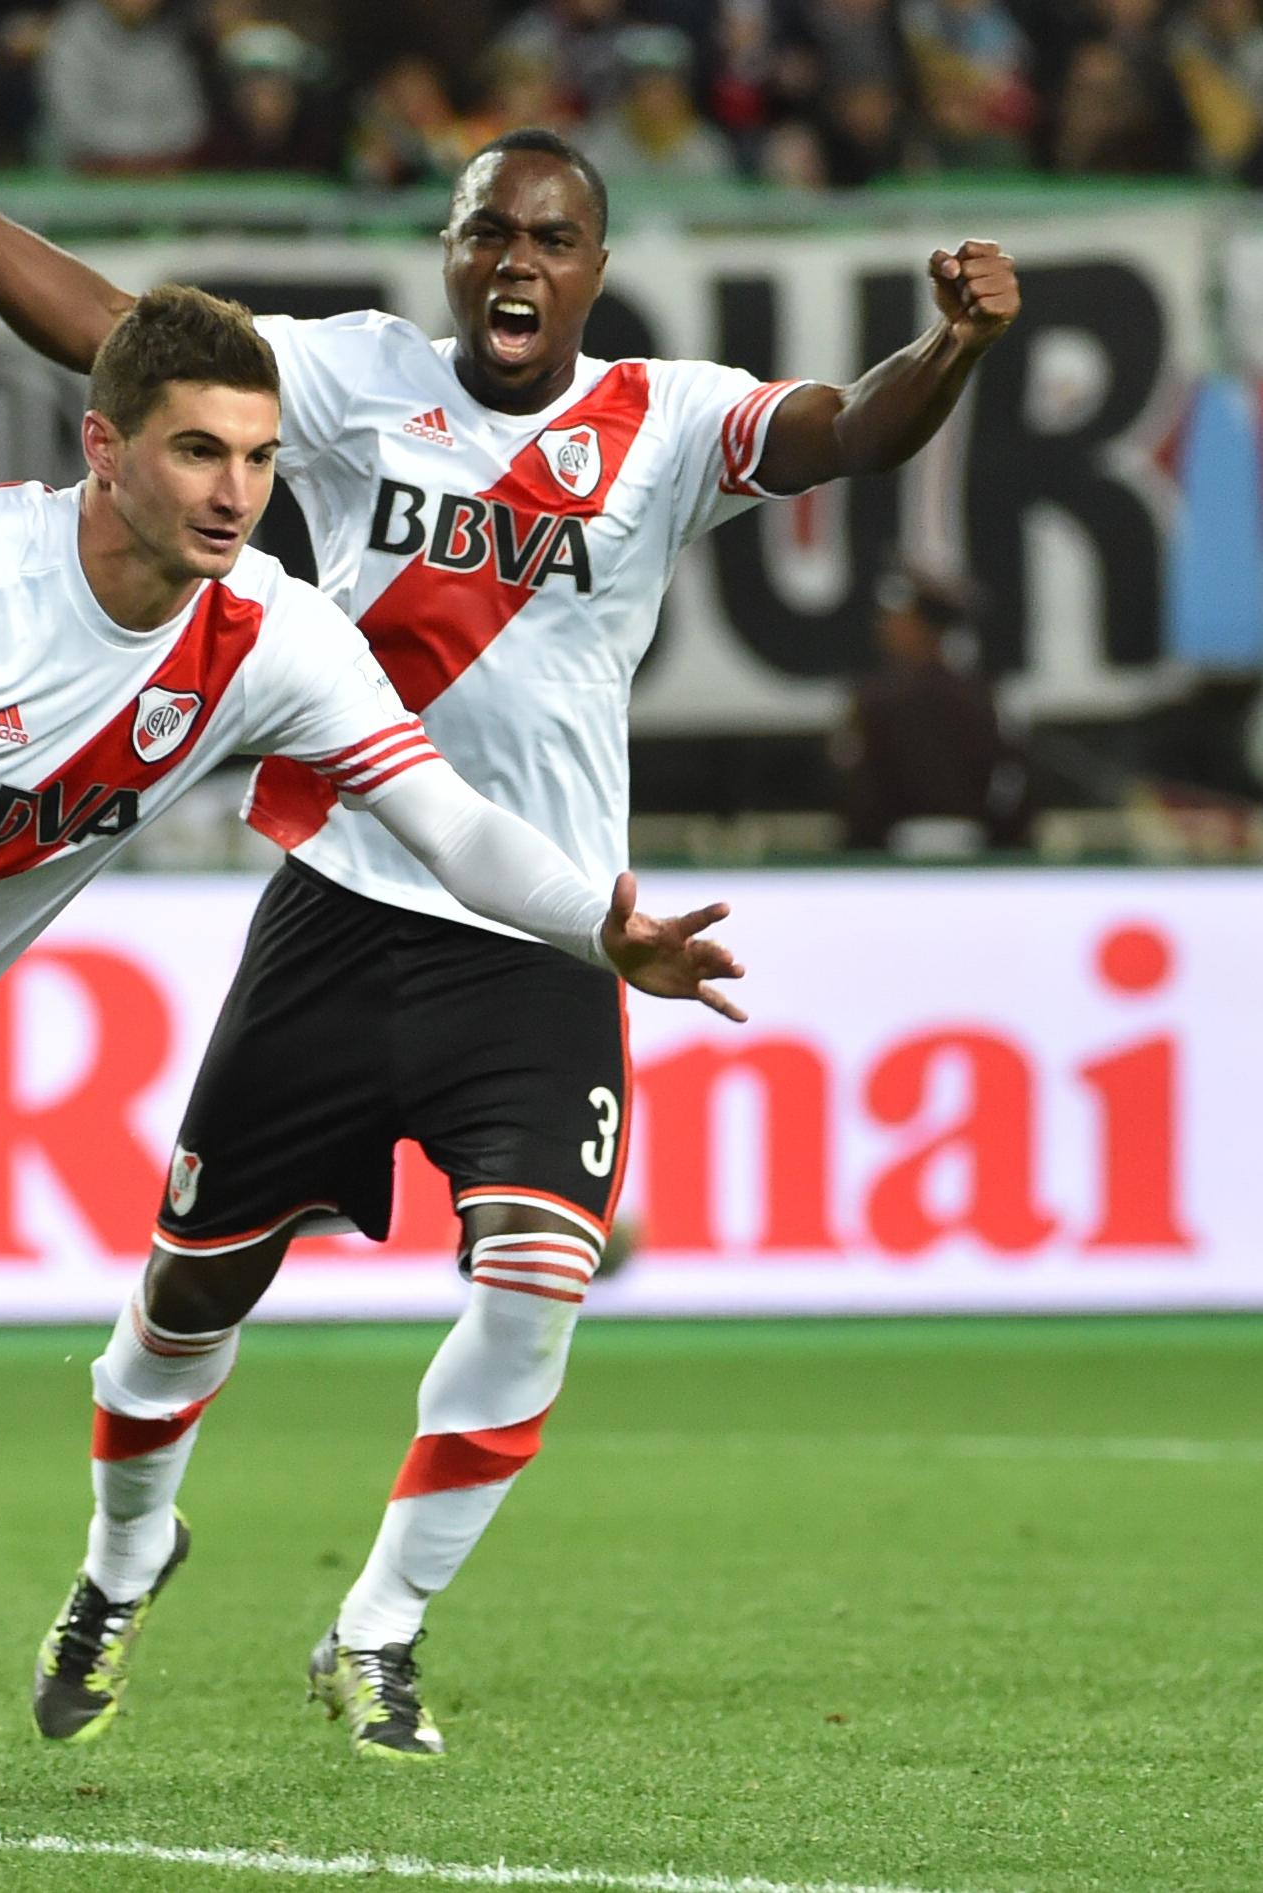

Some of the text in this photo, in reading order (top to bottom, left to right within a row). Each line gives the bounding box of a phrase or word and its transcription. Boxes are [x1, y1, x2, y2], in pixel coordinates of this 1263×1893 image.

[402, 421, 455, 447] adidas
[367, 476, 593, 596] BBVA
[580, 1086, 620, 1178] 3
